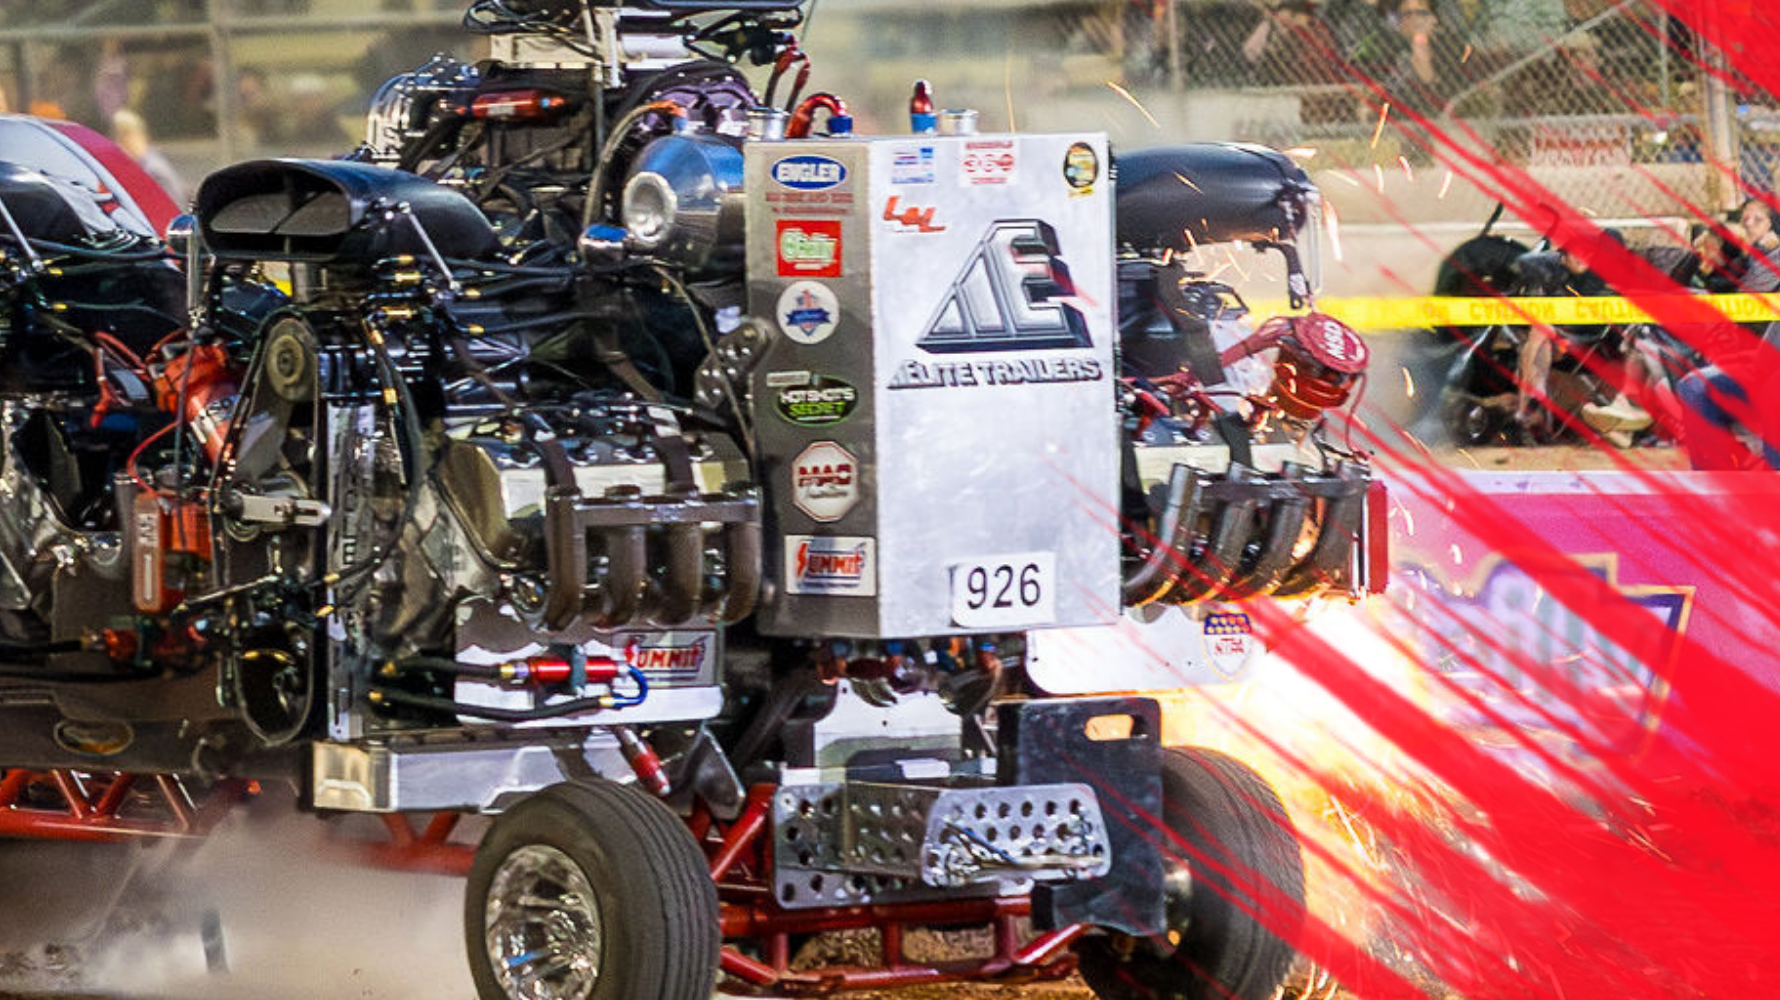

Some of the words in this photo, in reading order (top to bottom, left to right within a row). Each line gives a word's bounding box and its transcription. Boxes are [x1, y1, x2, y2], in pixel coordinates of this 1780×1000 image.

[892, 359, 978, 388] ELITE
[978, 358, 1103, 385] TRAILERS
[966, 563, 1042, 609] 926
